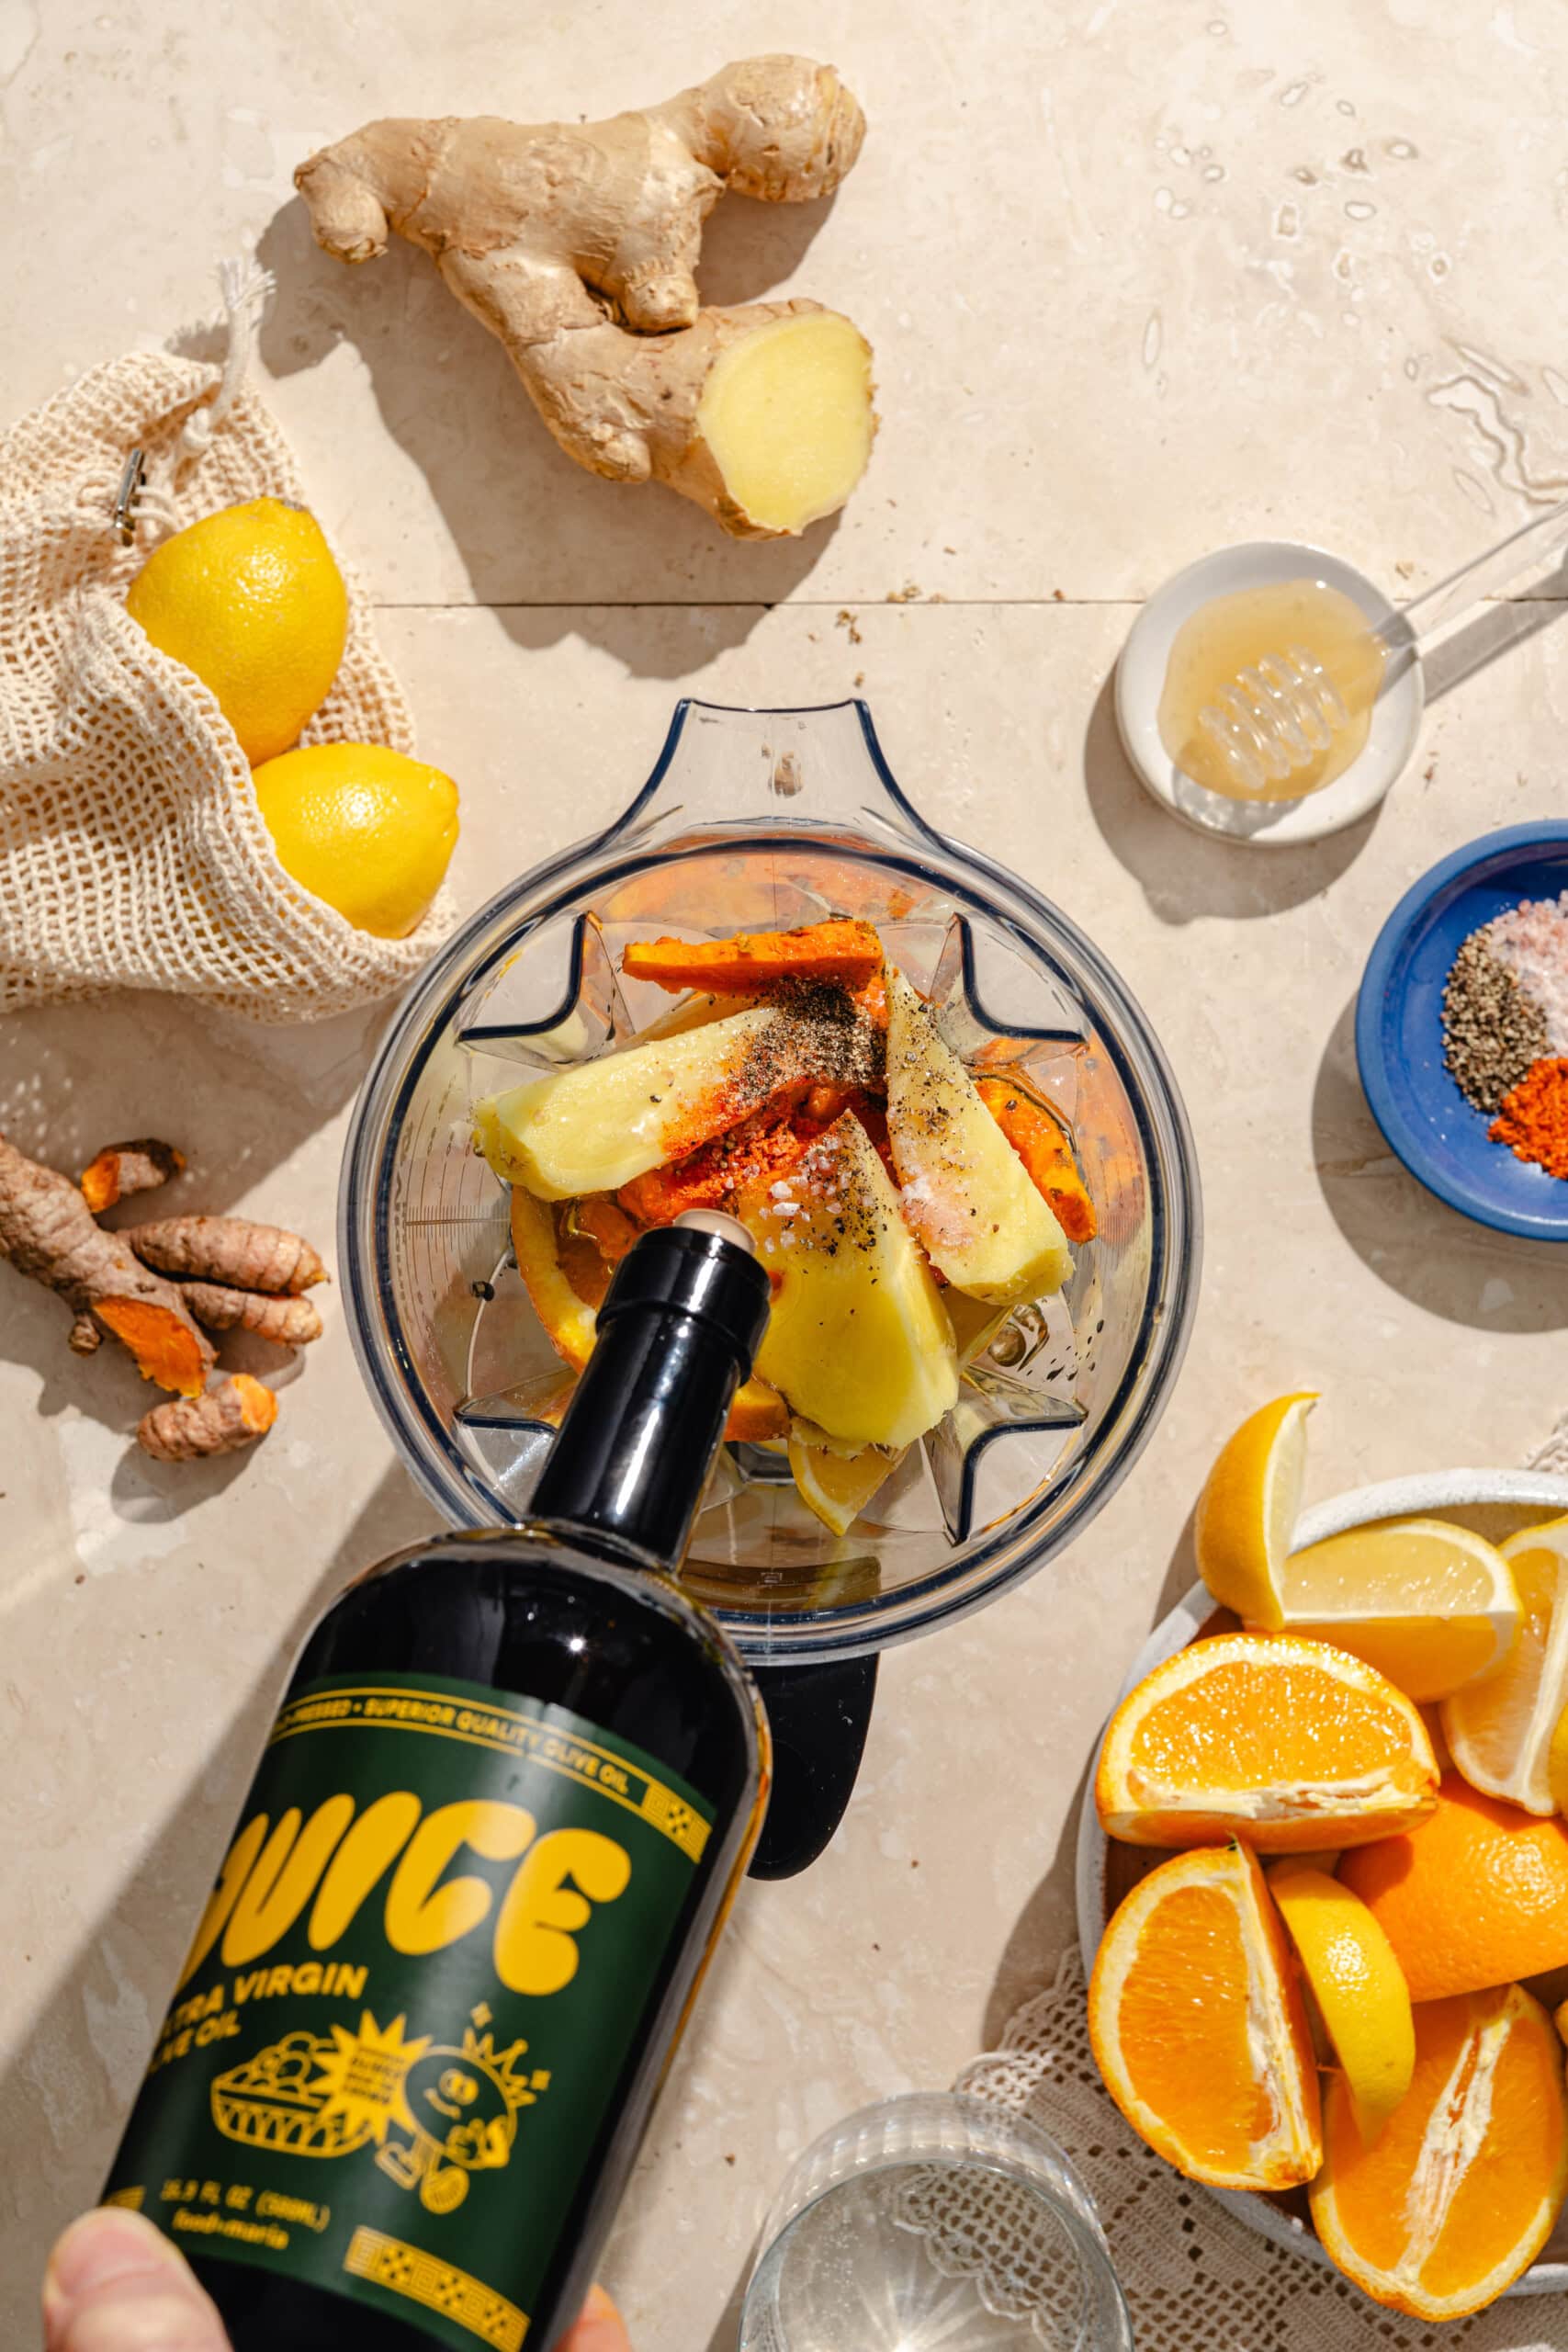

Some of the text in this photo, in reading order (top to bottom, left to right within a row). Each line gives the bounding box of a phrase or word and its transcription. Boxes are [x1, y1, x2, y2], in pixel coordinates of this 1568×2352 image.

[364, 1697, 456, 1726] SUPERIOR
[457, 1710, 540, 1747] QUALITY
[543, 1736, 600, 1777] OLIVE
[599, 1763, 629, 1794] OIL
[233, 1961, 368, 2005] VIRGIN
[194, 2010, 241, 2048] OIL
